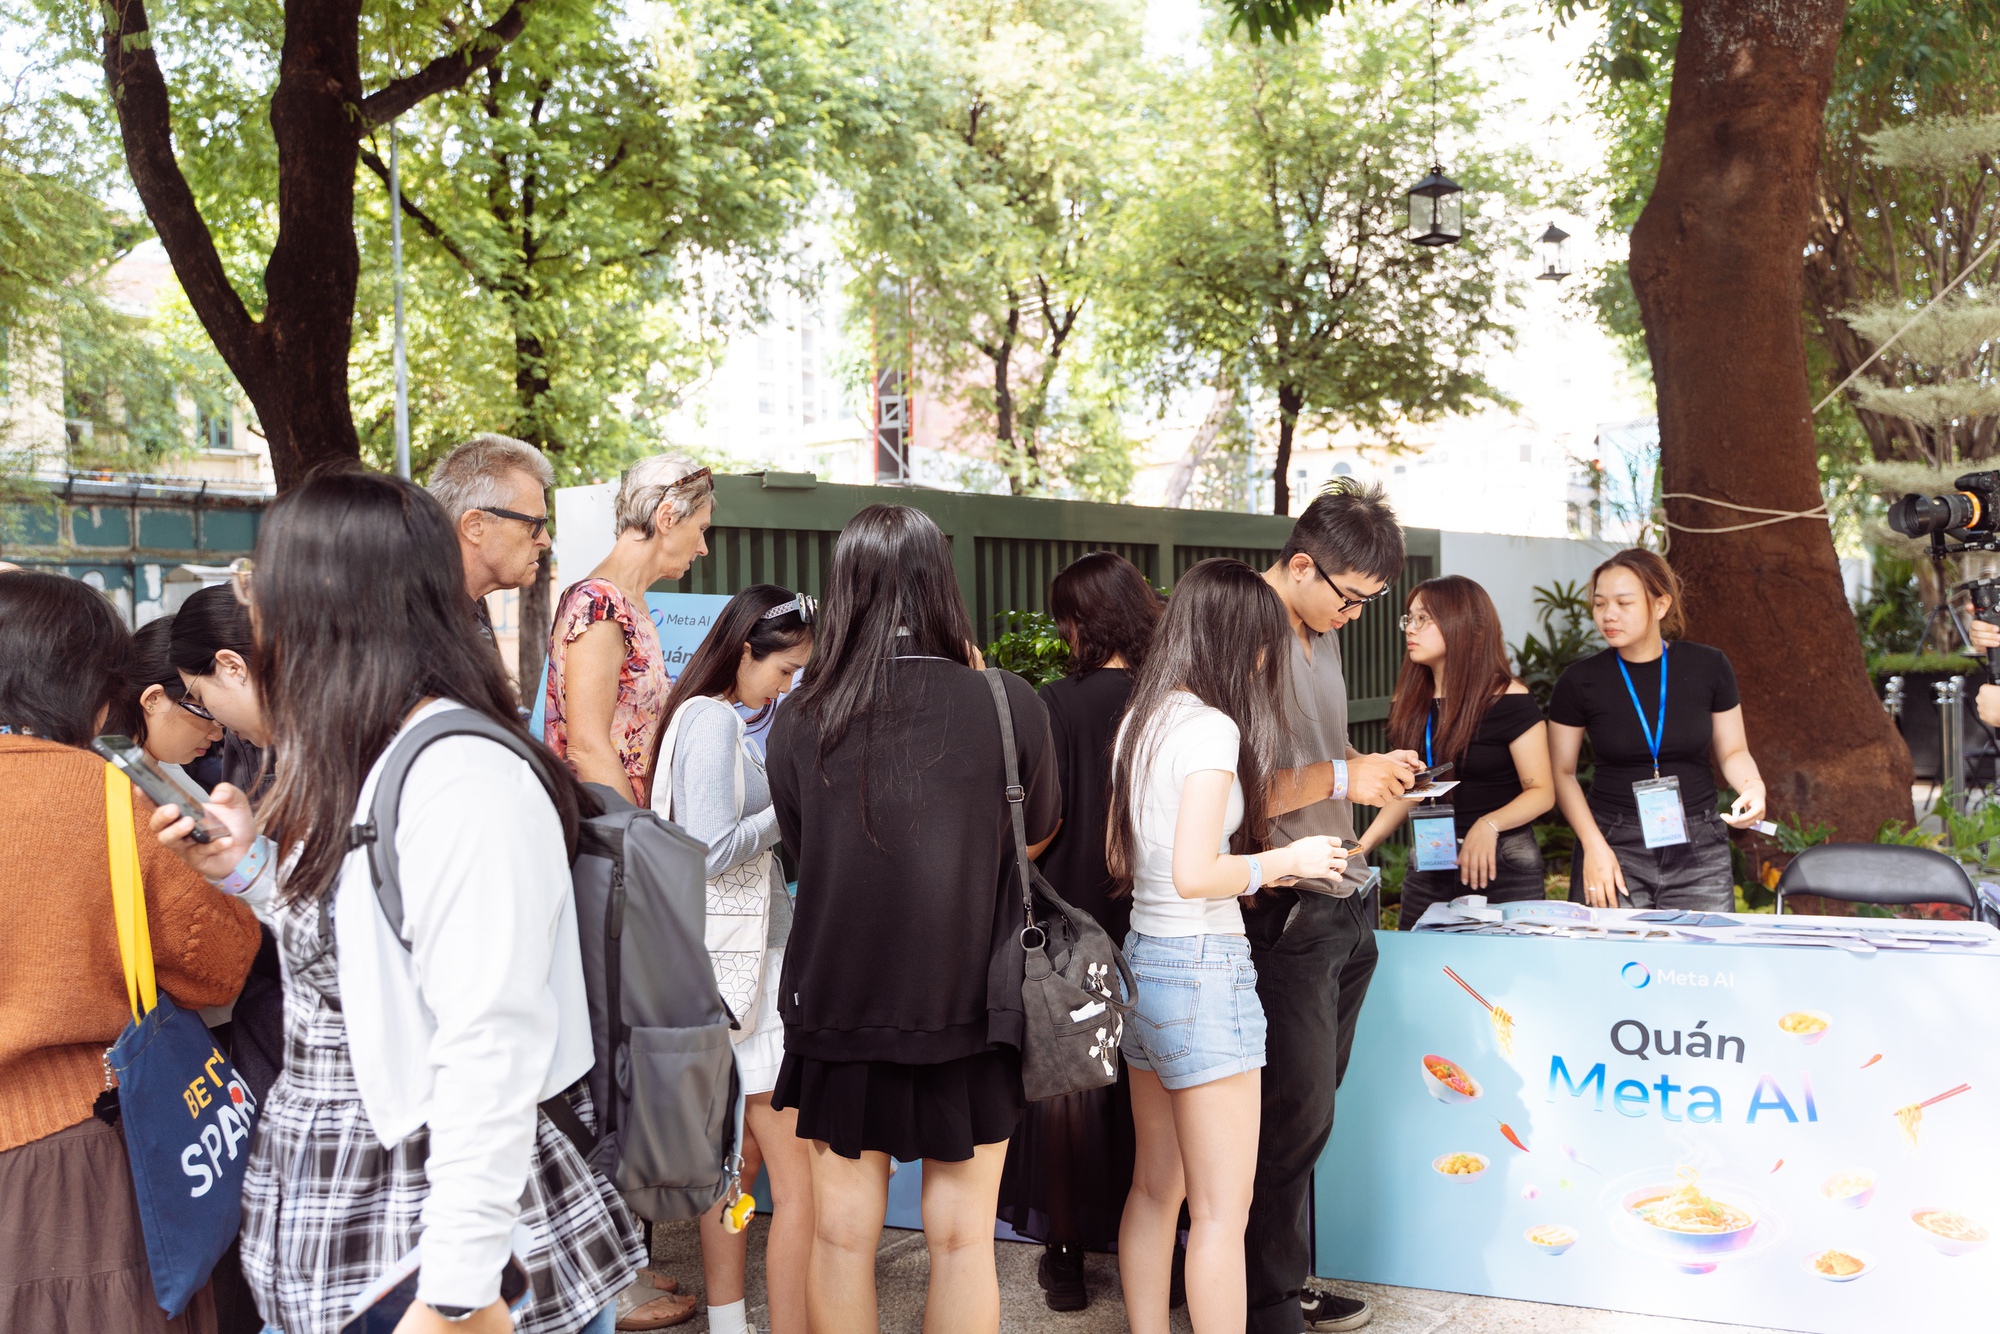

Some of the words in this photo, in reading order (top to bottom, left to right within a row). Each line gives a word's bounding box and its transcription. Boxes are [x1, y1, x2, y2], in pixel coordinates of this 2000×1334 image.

[666, 613, 696, 626] Meta
[697, 615, 711, 627] AI
[662, 646, 694, 664] uán
[1649, 833, 1683, 843] ORGANIZER
[1657, 968, 1709, 987] Meta
[1713, 972, 1735, 988] AI
[1610, 1019, 1746, 1064] Quán
[182, 1075, 213, 1120] BE
[1545, 1054, 1723, 1124] Meta
[1745, 1070, 1819, 1124] AI
